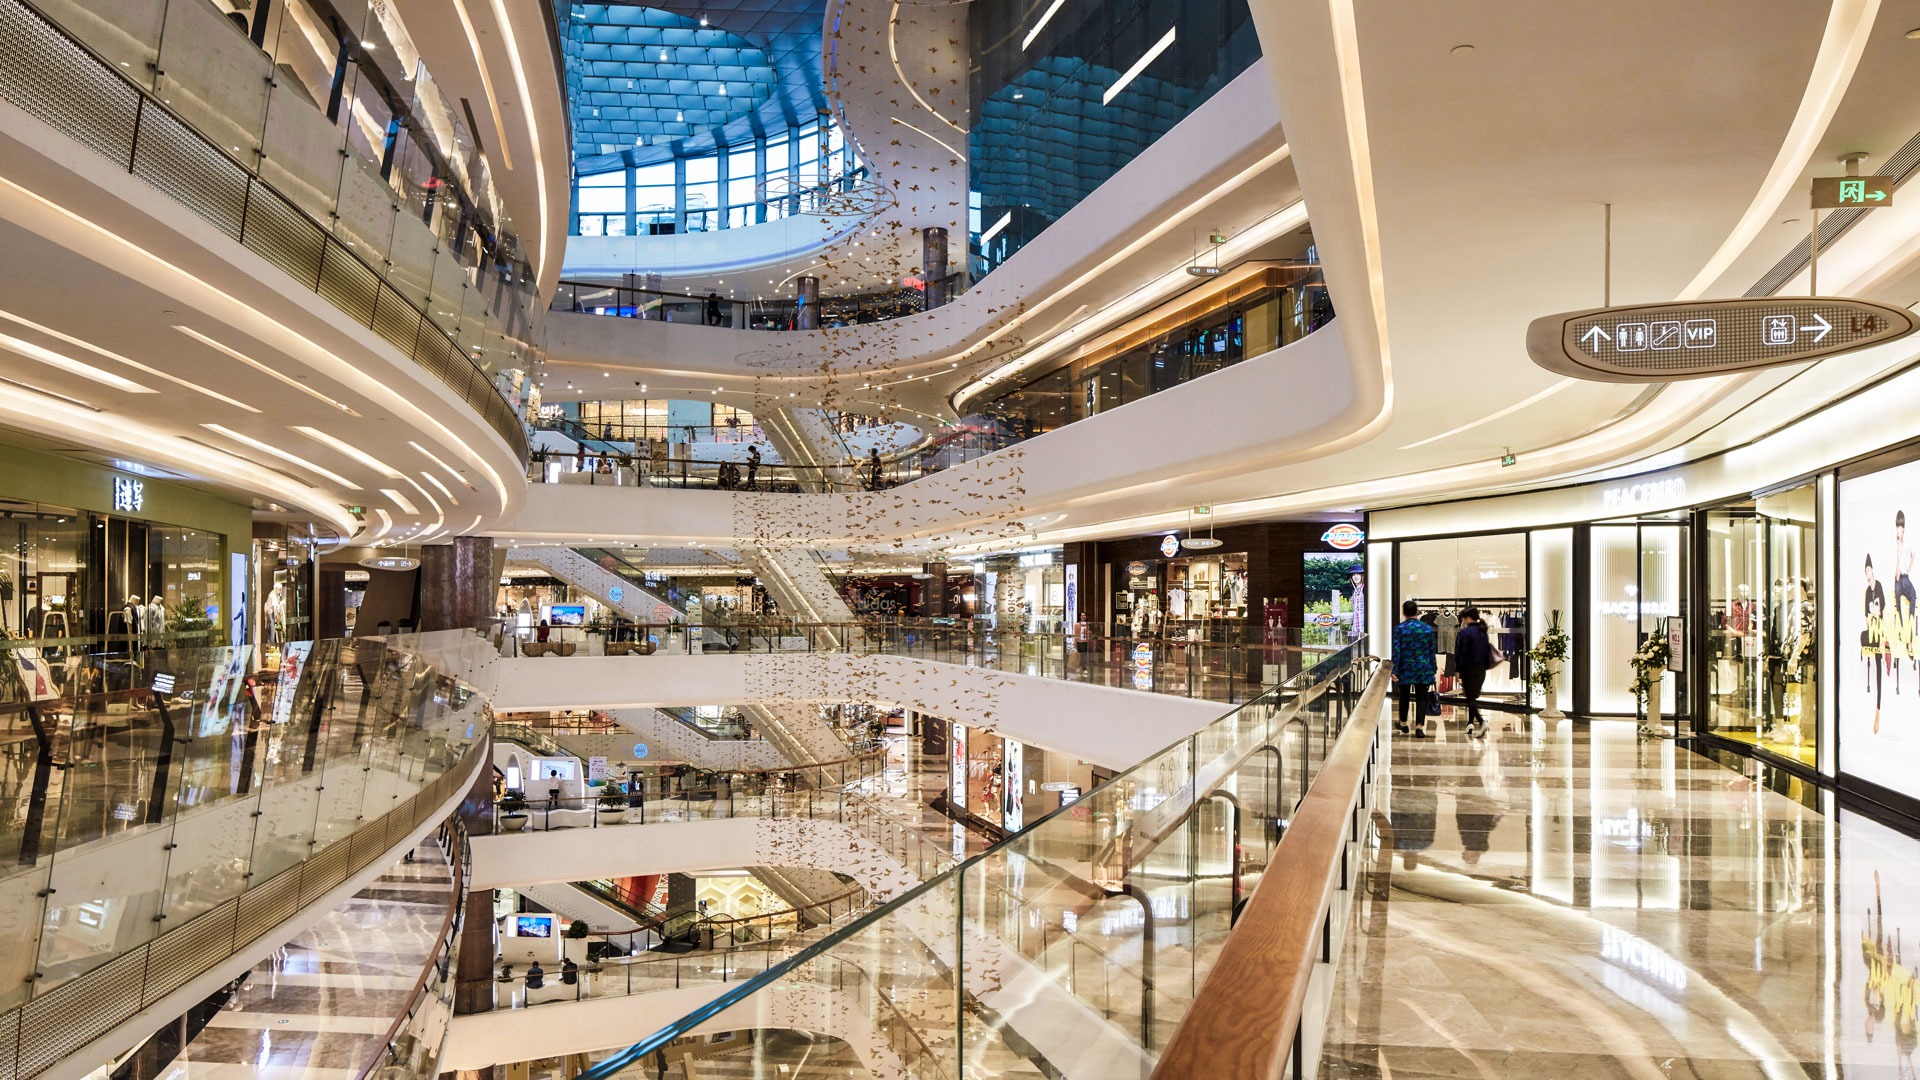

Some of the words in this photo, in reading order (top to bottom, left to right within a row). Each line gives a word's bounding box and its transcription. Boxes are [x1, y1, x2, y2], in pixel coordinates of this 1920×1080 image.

[1851, 316, 1876, 333] L4
[1687, 327, 1713, 340] VIP
[1603, 477, 1686, 512] PEACEBIRD
[849, 596, 897, 610] didas
